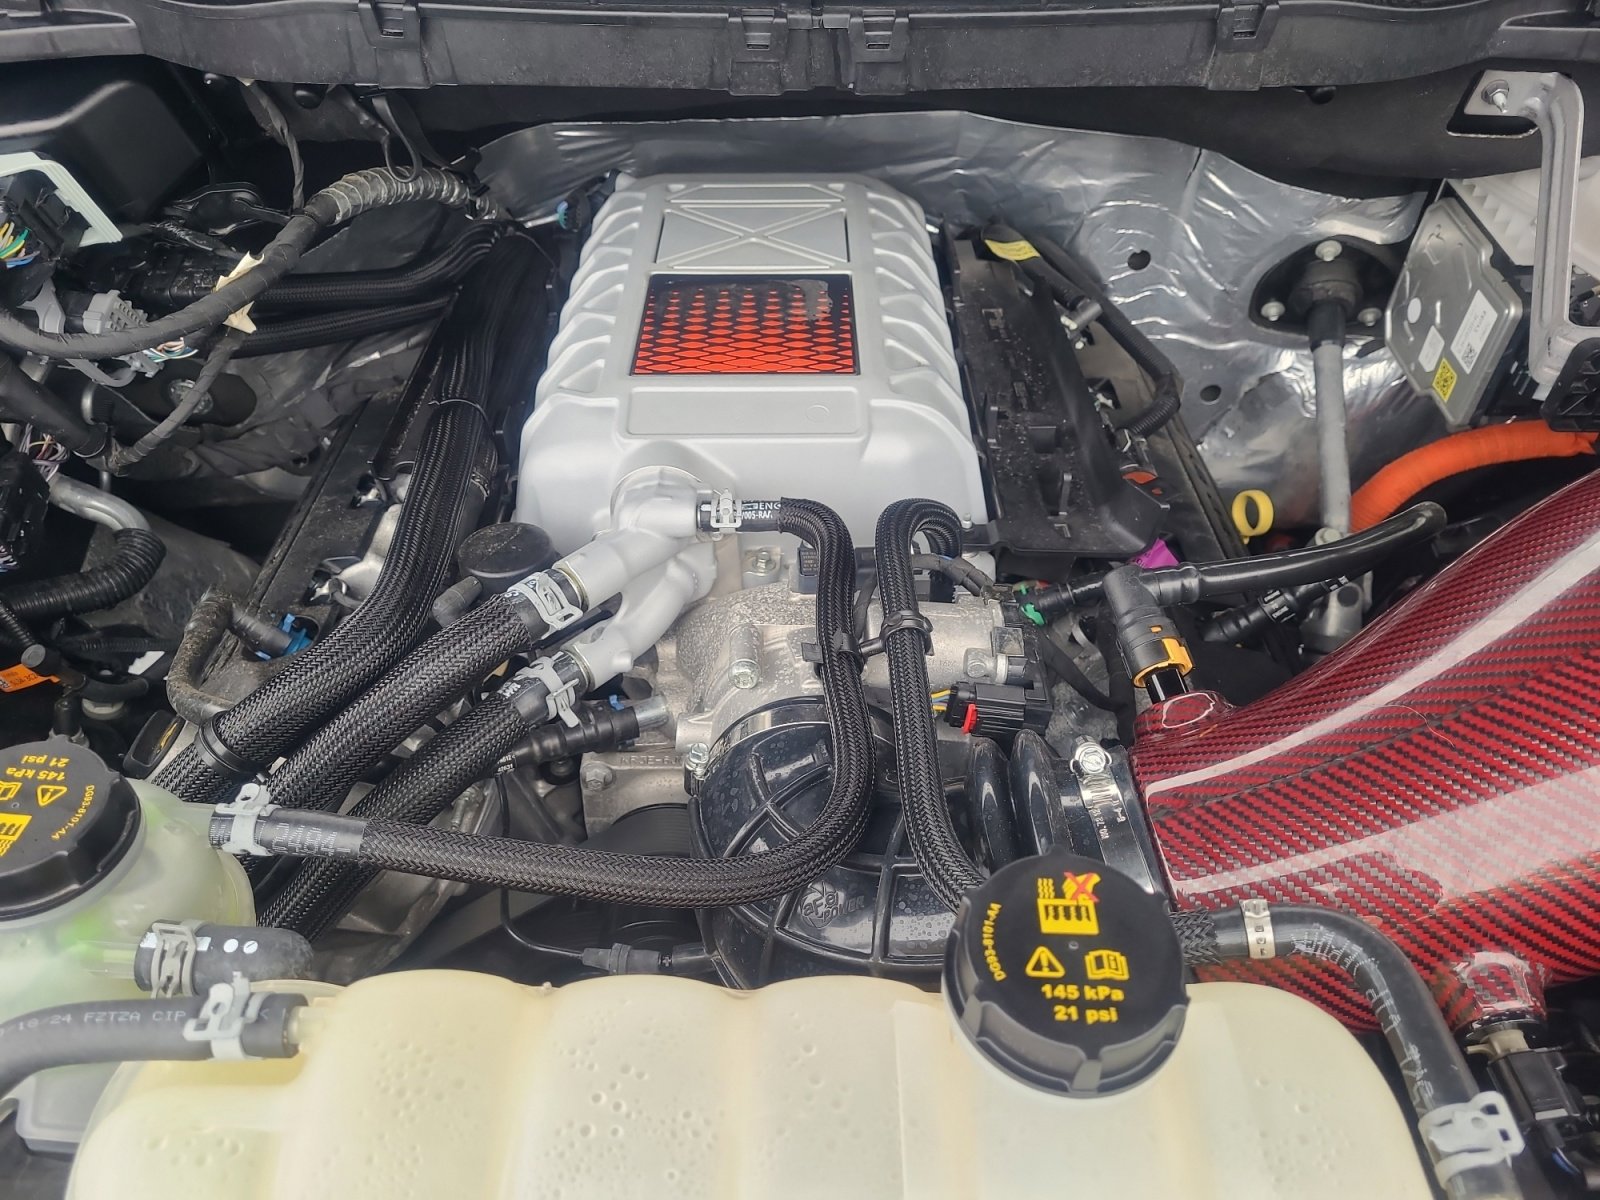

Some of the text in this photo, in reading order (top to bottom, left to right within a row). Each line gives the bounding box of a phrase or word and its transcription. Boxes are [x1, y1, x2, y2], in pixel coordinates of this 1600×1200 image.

[21, 755, 70, 768] 21 psi
[6, 767, 66, 781] 145 kPa
[1041, 984, 1124, 1001] 145 kPa
[152, 1010, 186, 1022] CIP
[1053, 1005, 1118, 1025] 21 psi
